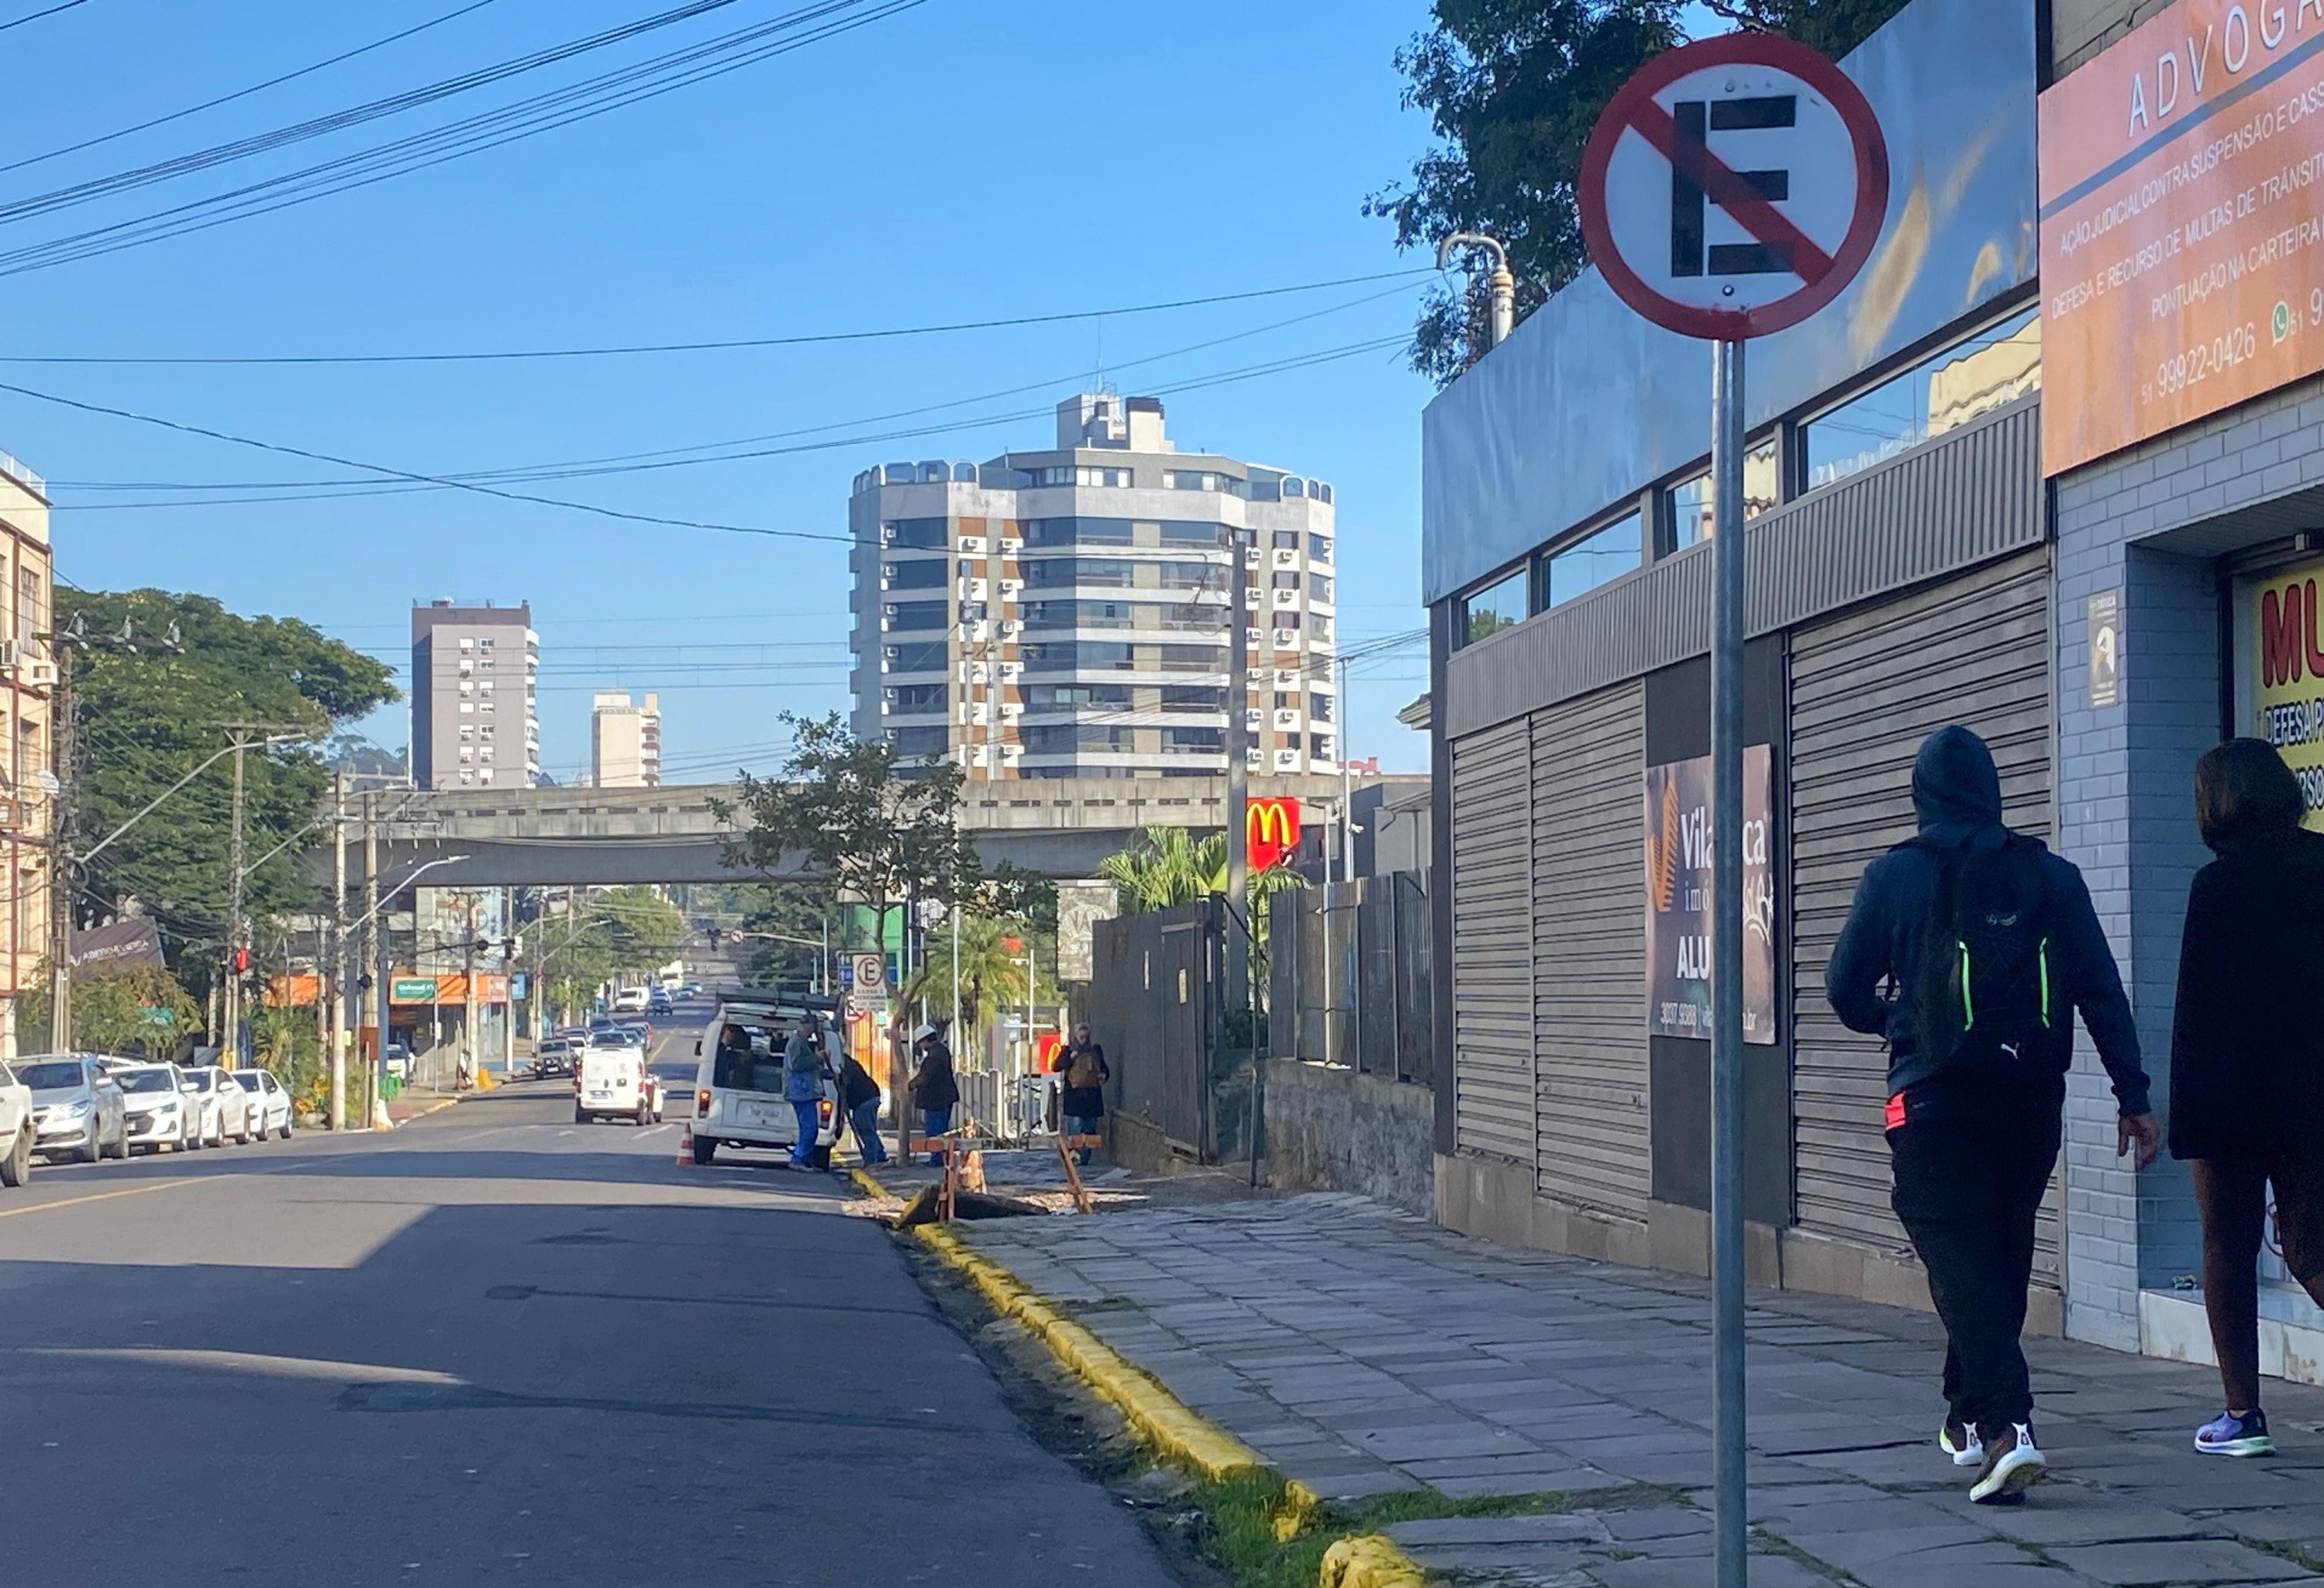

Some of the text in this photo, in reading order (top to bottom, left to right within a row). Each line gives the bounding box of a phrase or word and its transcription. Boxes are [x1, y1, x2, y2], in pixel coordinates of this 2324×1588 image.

[1671, 95, 1797, 277] E
[2052, 152, 2324, 320] DEFESA E RECURSO DE MULTAS DE TRÂNSIT
[2060, 221, 2091, 257] AÇÃO
[2091, 191, 2142, 239] JUDICIAL
[2142, 160, 2191, 209] CONTRA
[2191, 112, 2274, 180] SUSPENSÃO
[2277, 104, 2287, 132] E
[2151, 217, 2320, 322] PONTUAÇÃO NA CARTEIRA
[2141, 287, 2324, 406] 51 99922-0426 51 9
[2264, 697, 2324, 748] DEFESA P
[864, 961, 875, 980] E
